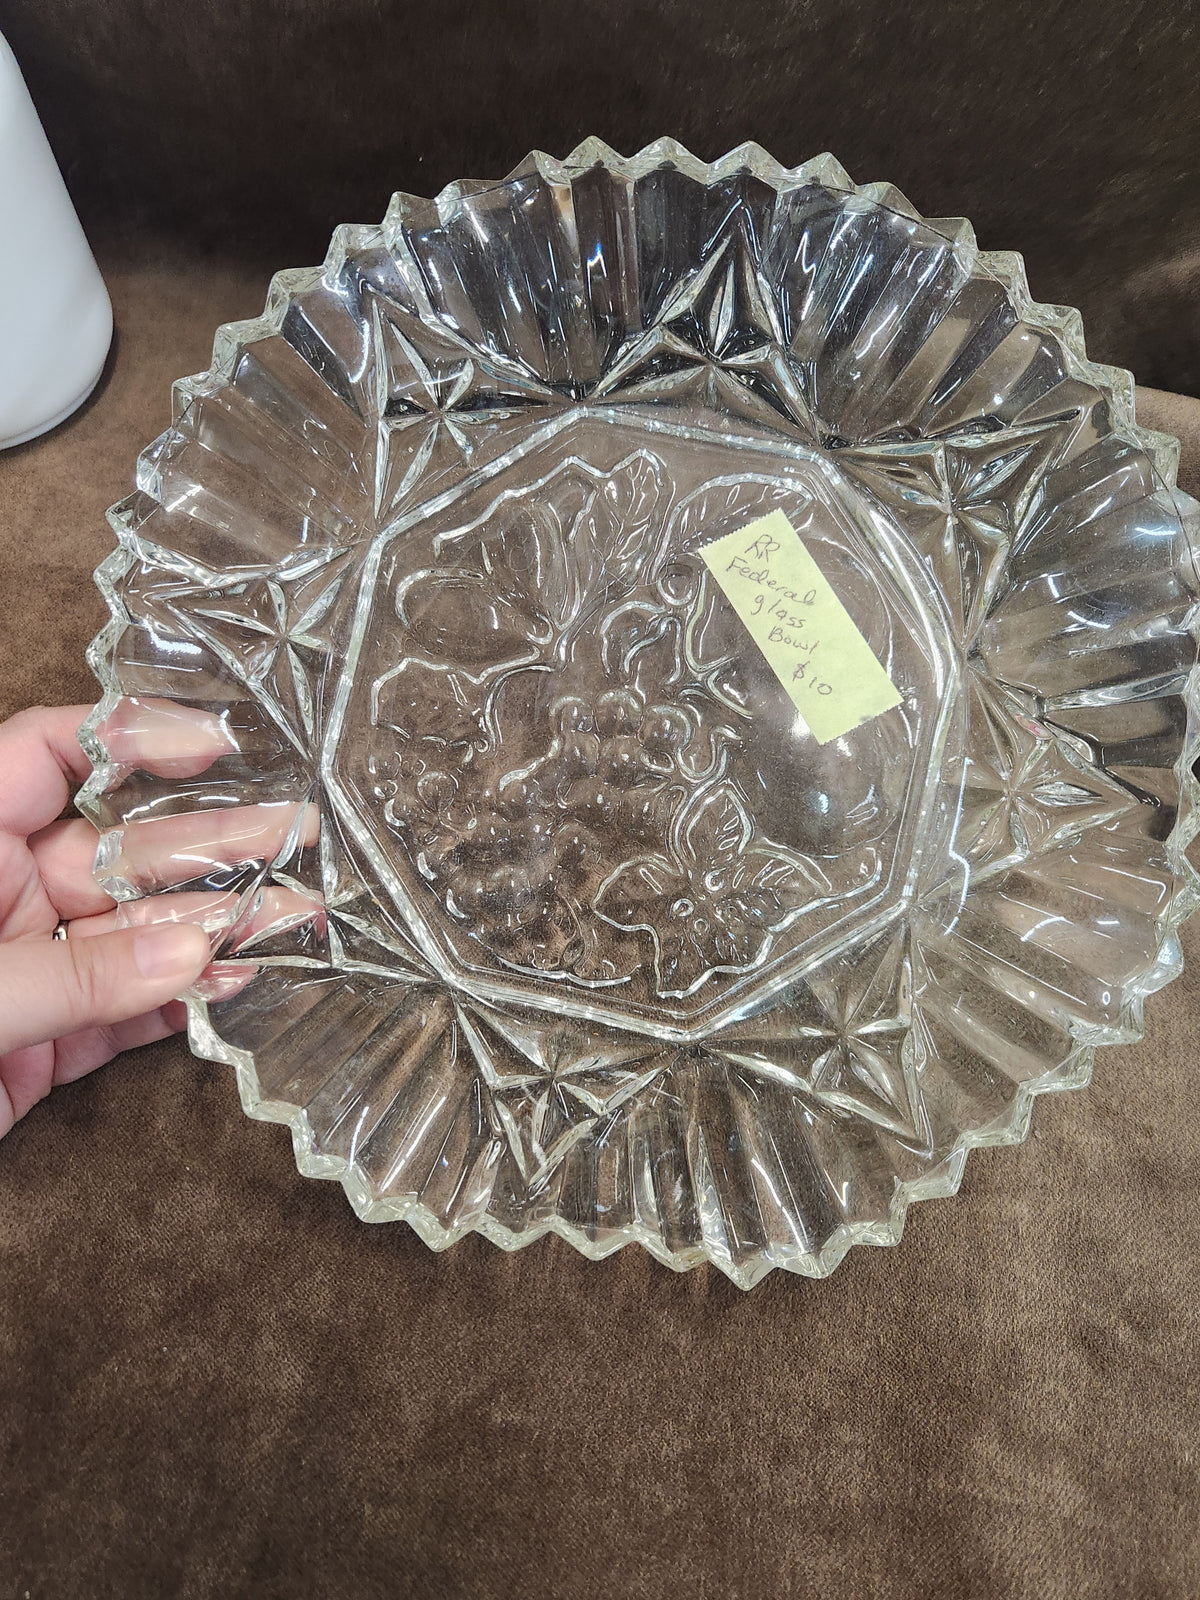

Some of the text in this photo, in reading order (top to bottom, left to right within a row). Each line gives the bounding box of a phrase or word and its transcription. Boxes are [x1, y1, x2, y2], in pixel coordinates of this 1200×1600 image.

[725, 556, 817, 606] Federal
[750, 594, 807, 629] glass
[767, 625, 820, 655] Bowl
[792, 660, 833, 696] $10
